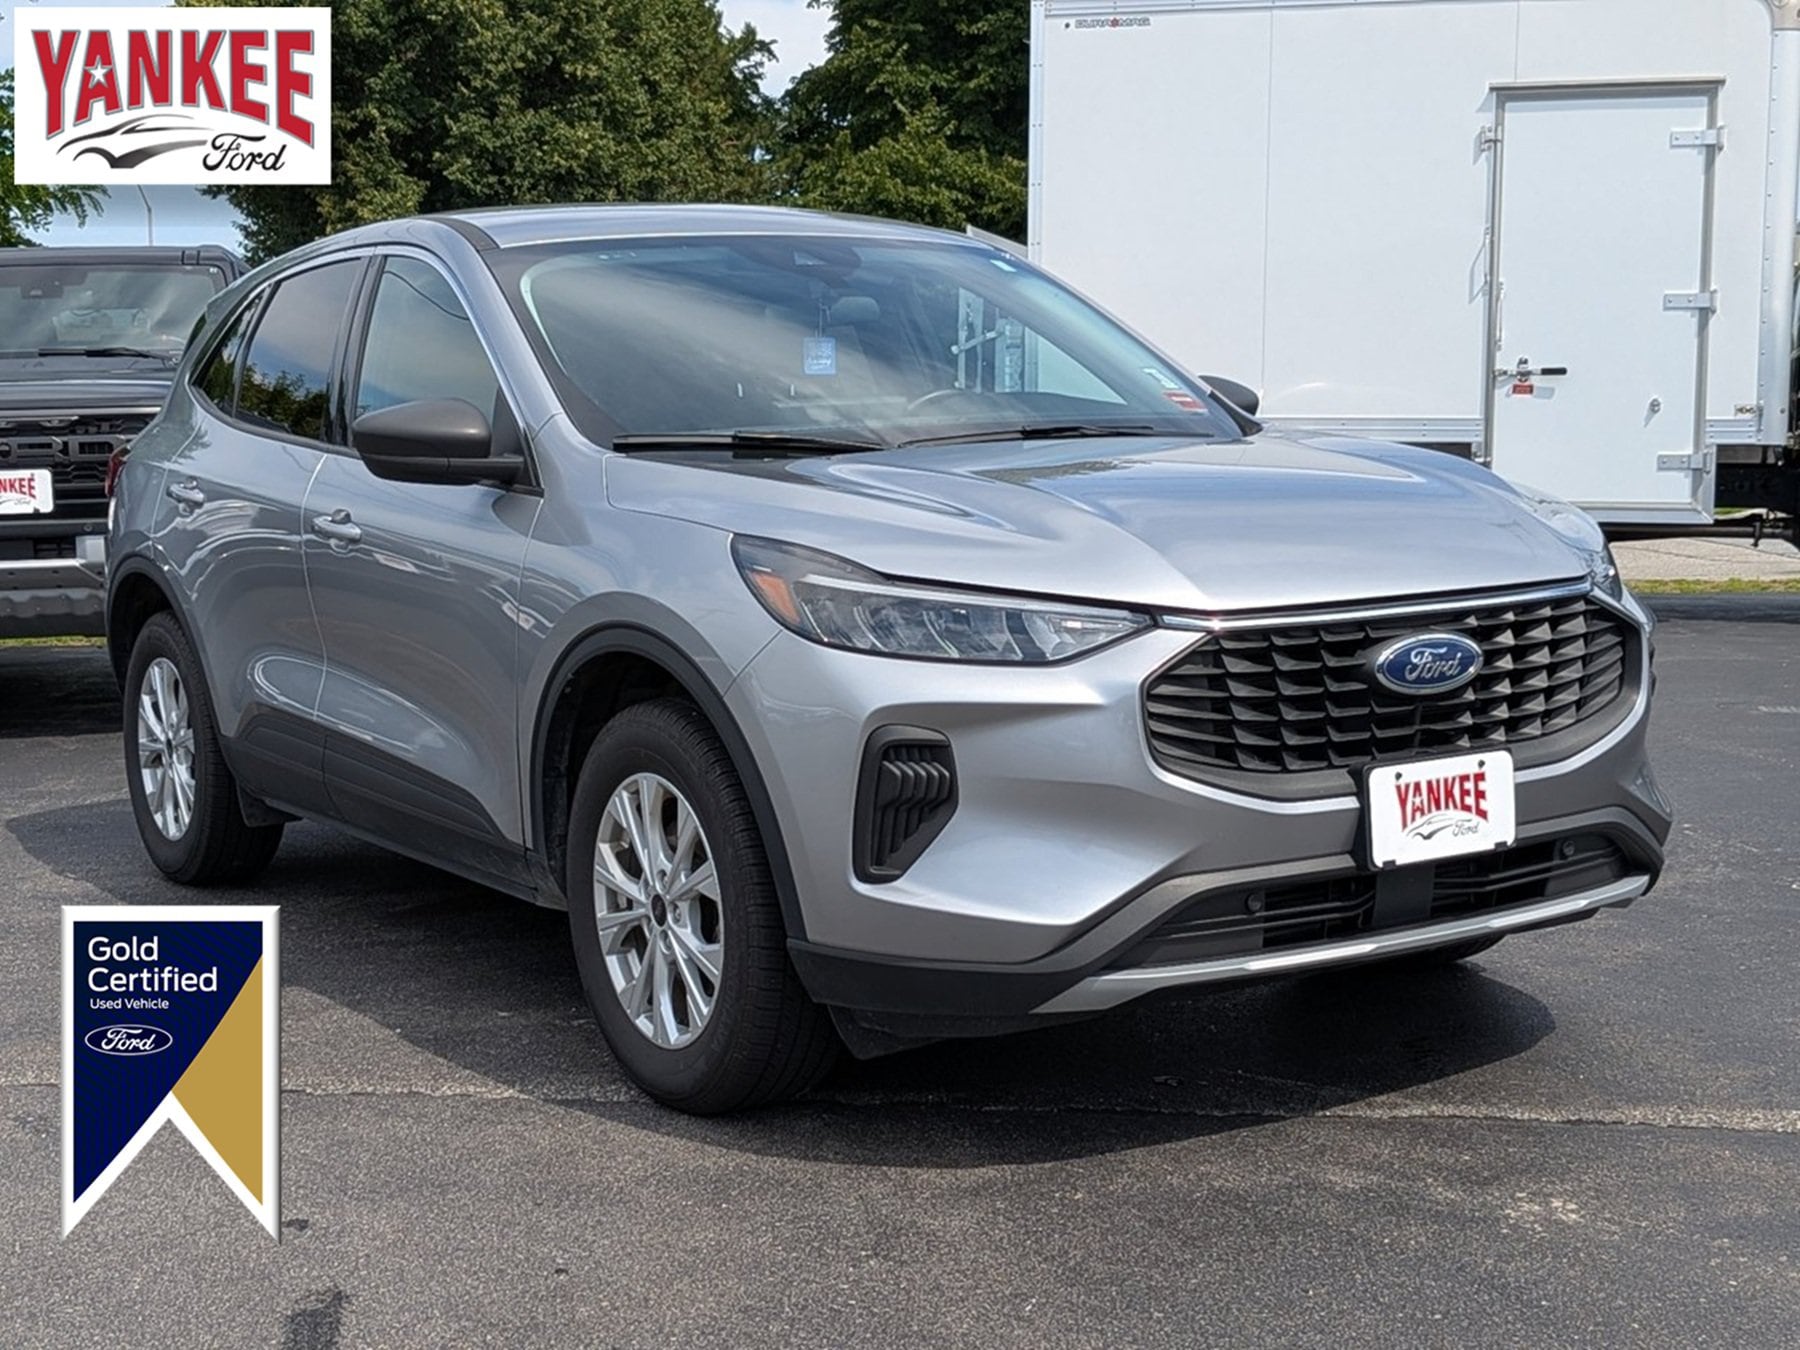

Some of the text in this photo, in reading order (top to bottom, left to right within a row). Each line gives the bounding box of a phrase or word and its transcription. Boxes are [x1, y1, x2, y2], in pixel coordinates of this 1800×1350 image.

[1404, 646, 1462, 681] Ford
[1395, 771, 1489, 833] YANKEE
[1452, 818, 1480, 837] Ford
